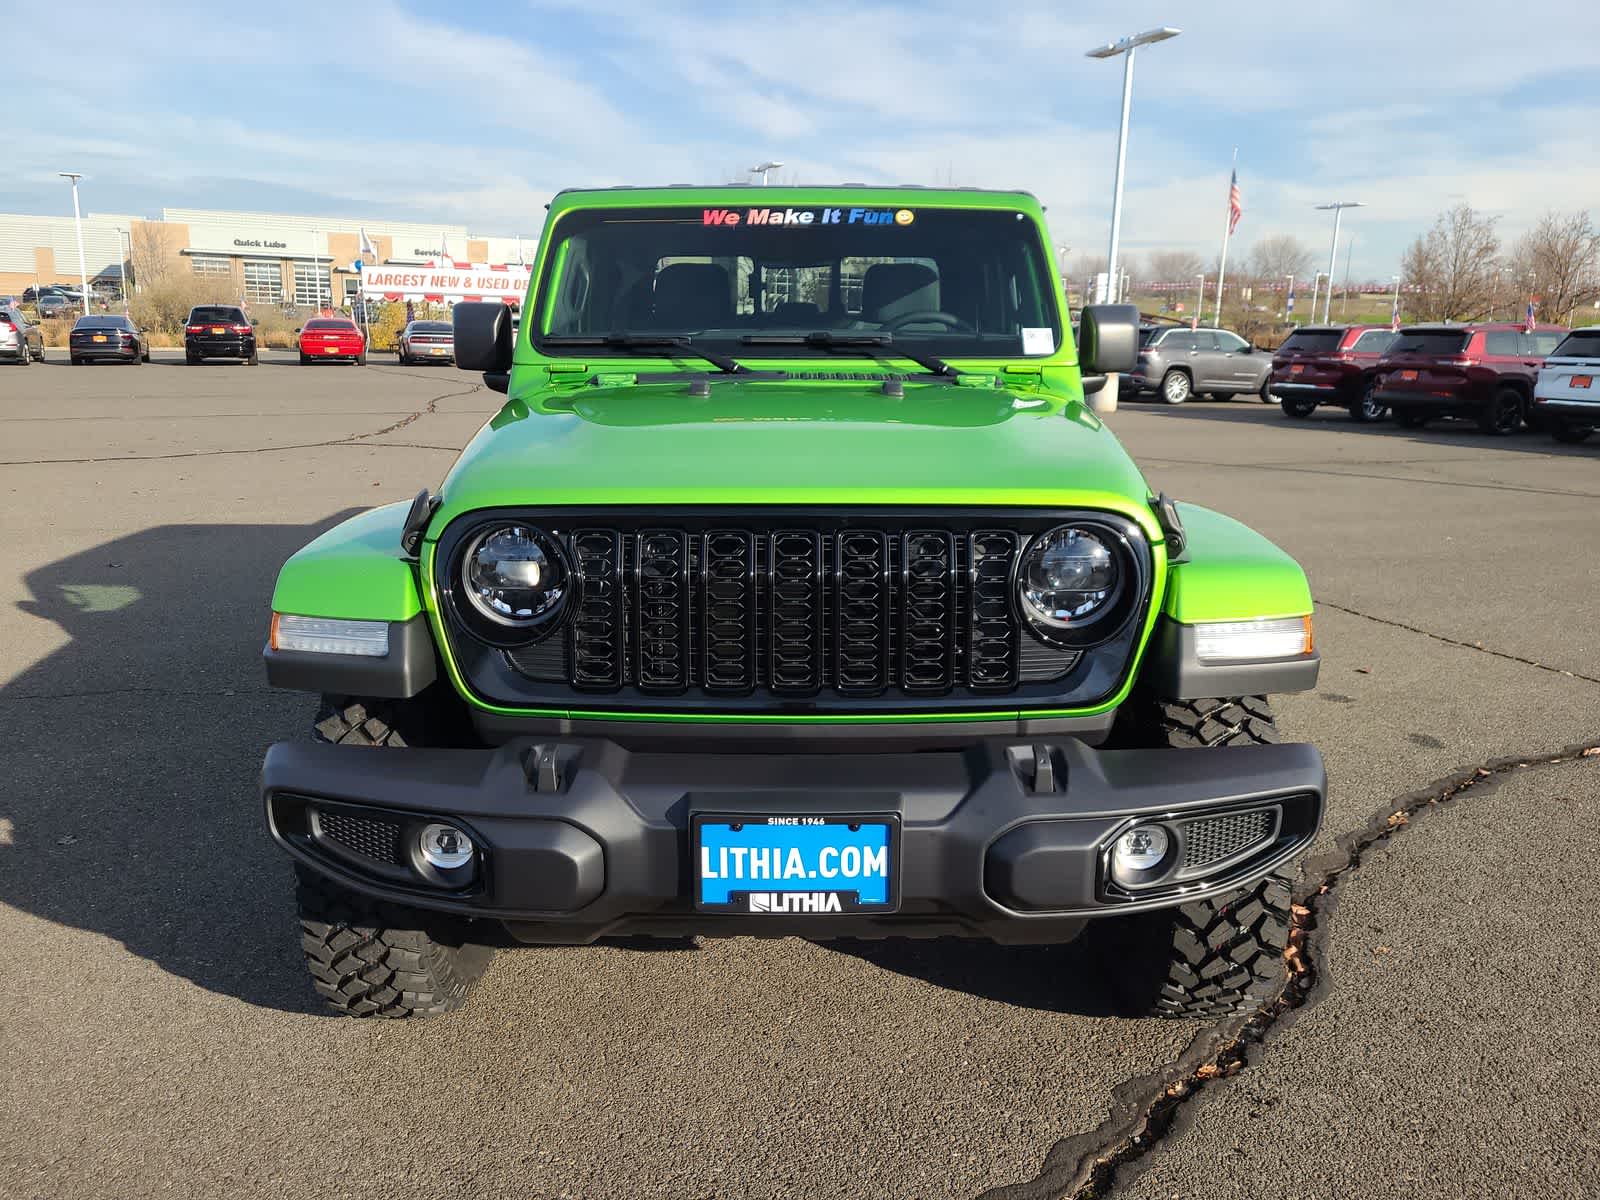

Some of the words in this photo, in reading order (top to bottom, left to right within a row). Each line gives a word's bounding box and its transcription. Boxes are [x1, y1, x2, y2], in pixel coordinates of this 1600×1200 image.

[702, 208, 740, 225] We
[746, 208, 814, 225] Make
[821, 207, 842, 225] It
[847, 208, 894, 225] Fun
[233, 238, 262, 248] Quick
[263, 239, 287, 249] Lube
[413, 248, 443, 257] Servic
[367, 272, 427, 288] LARGEST
[430, 274, 460, 289] NEW
[463, 275, 473, 289] &
[477, 276, 509, 290] USED
[767, 817, 799, 826] SINCE
[802, 817, 826, 826] 1946
[701, 845, 888, 880] LITHIA.COM
[770, 892, 843, 913] LITHIA
